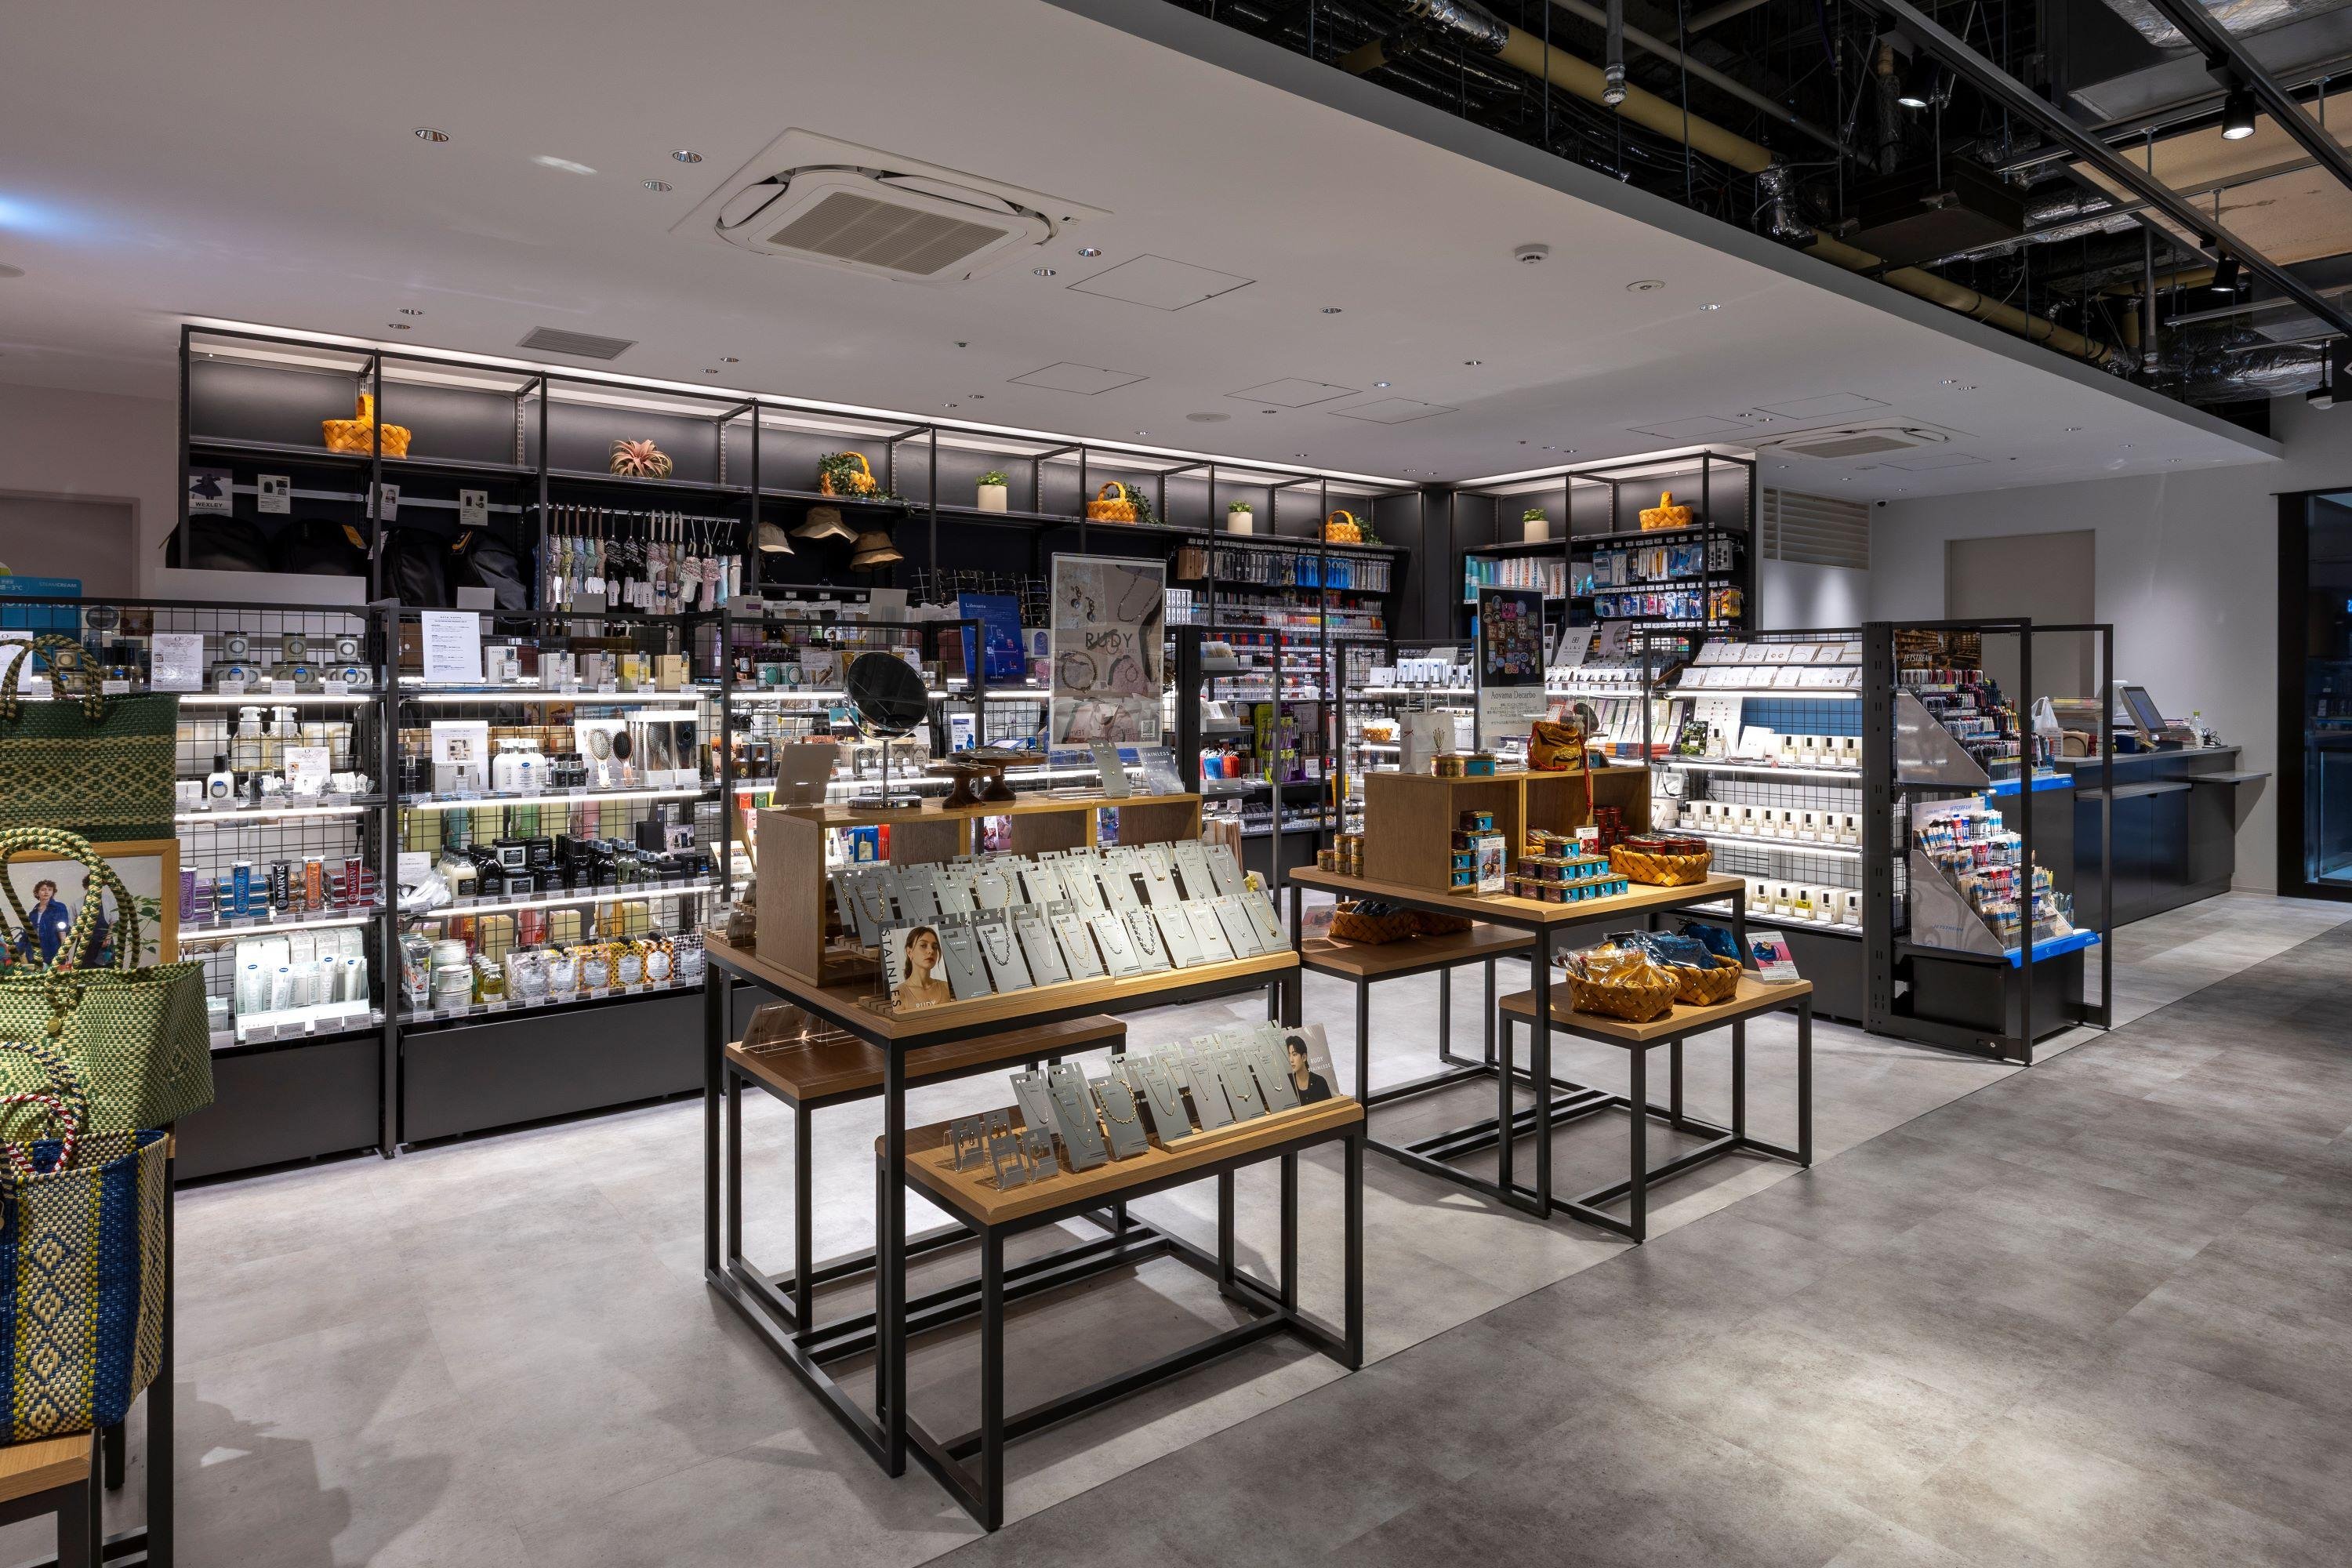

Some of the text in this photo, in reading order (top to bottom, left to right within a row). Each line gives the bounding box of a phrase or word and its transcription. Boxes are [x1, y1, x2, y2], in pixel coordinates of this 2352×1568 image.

[1085, 631, 1133, 648] RUDY
[1903, 654, 1933, 662] JETSTREAM
[1490, 691, 1537, 701] Aoyama Decarbo
[182, 872, 191, 908] MARVIS
[915, 1000, 936, 1009] RUDY
